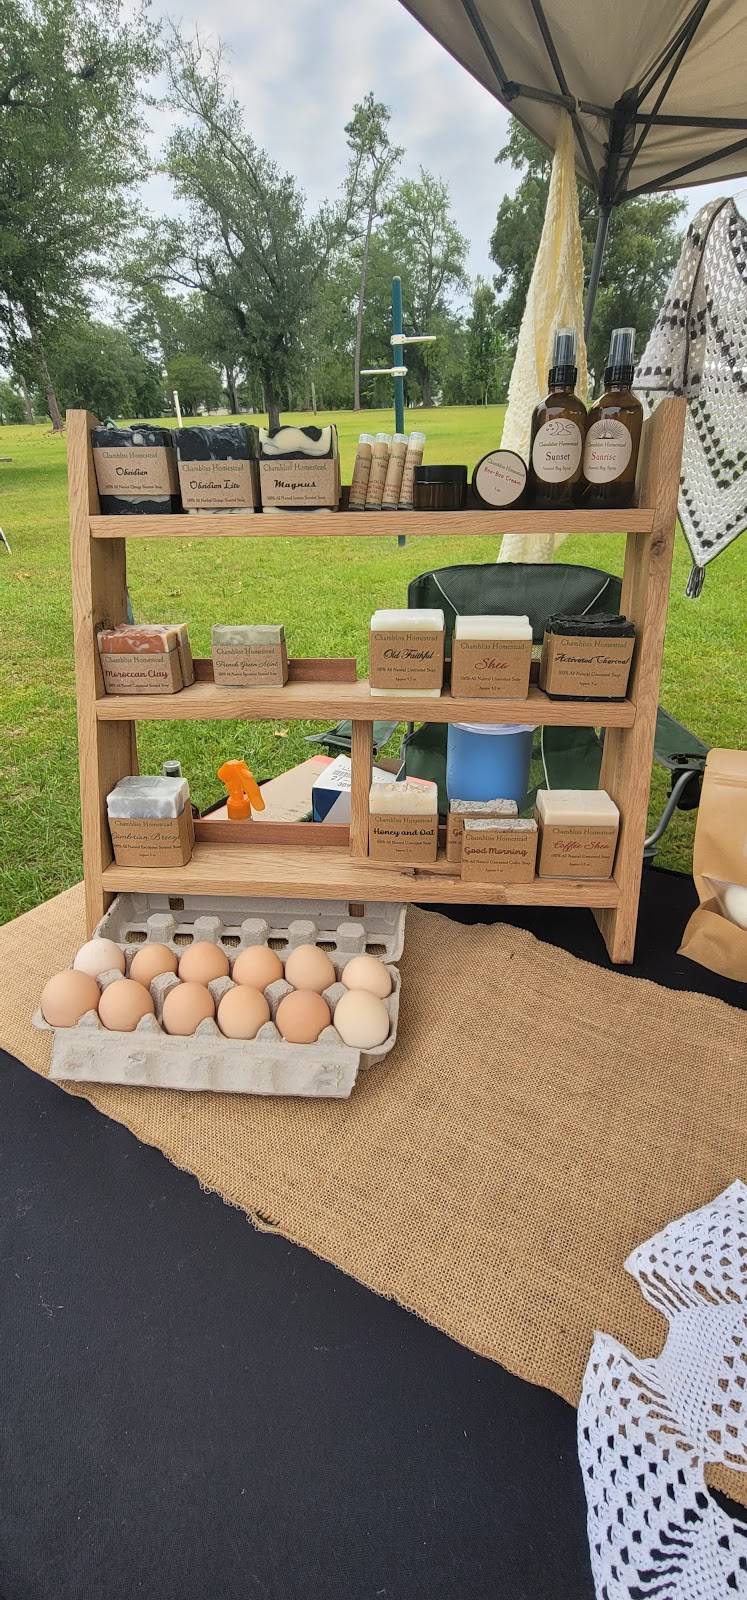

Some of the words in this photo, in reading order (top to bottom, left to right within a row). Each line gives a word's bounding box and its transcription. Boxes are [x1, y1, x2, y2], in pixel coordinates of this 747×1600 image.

[546, 452, 570, 460] Sunset
[591, 452, 616, 460] Sunrise
[116, 467, 147, 475] Obsidian
[484, 467, 504, 478] Boo-Boo
[506, 476, 521, 485] Cream
[190, 481, 221, 489] Obsidian
[224, 480, 240, 489] Lite
[274, 480, 317, 490] Magnus
[561, 639, 592, 647] Chambliss
[383, 649, 401, 659] Old
[401, 649, 435, 662] Faithful
[555, 653, 594, 664] Activated
[596, 656, 630, 664] Charcoal
[240, 661, 258, 670] Green
[474, 658, 510, 669] Shea
[148, 670, 168, 678] Clay
[374, 828, 400, 837] Honey
[553, 841, 582, 852] Coffee
[464, 847, 488, 855] Good
[489, 848, 528, 857] Morning
